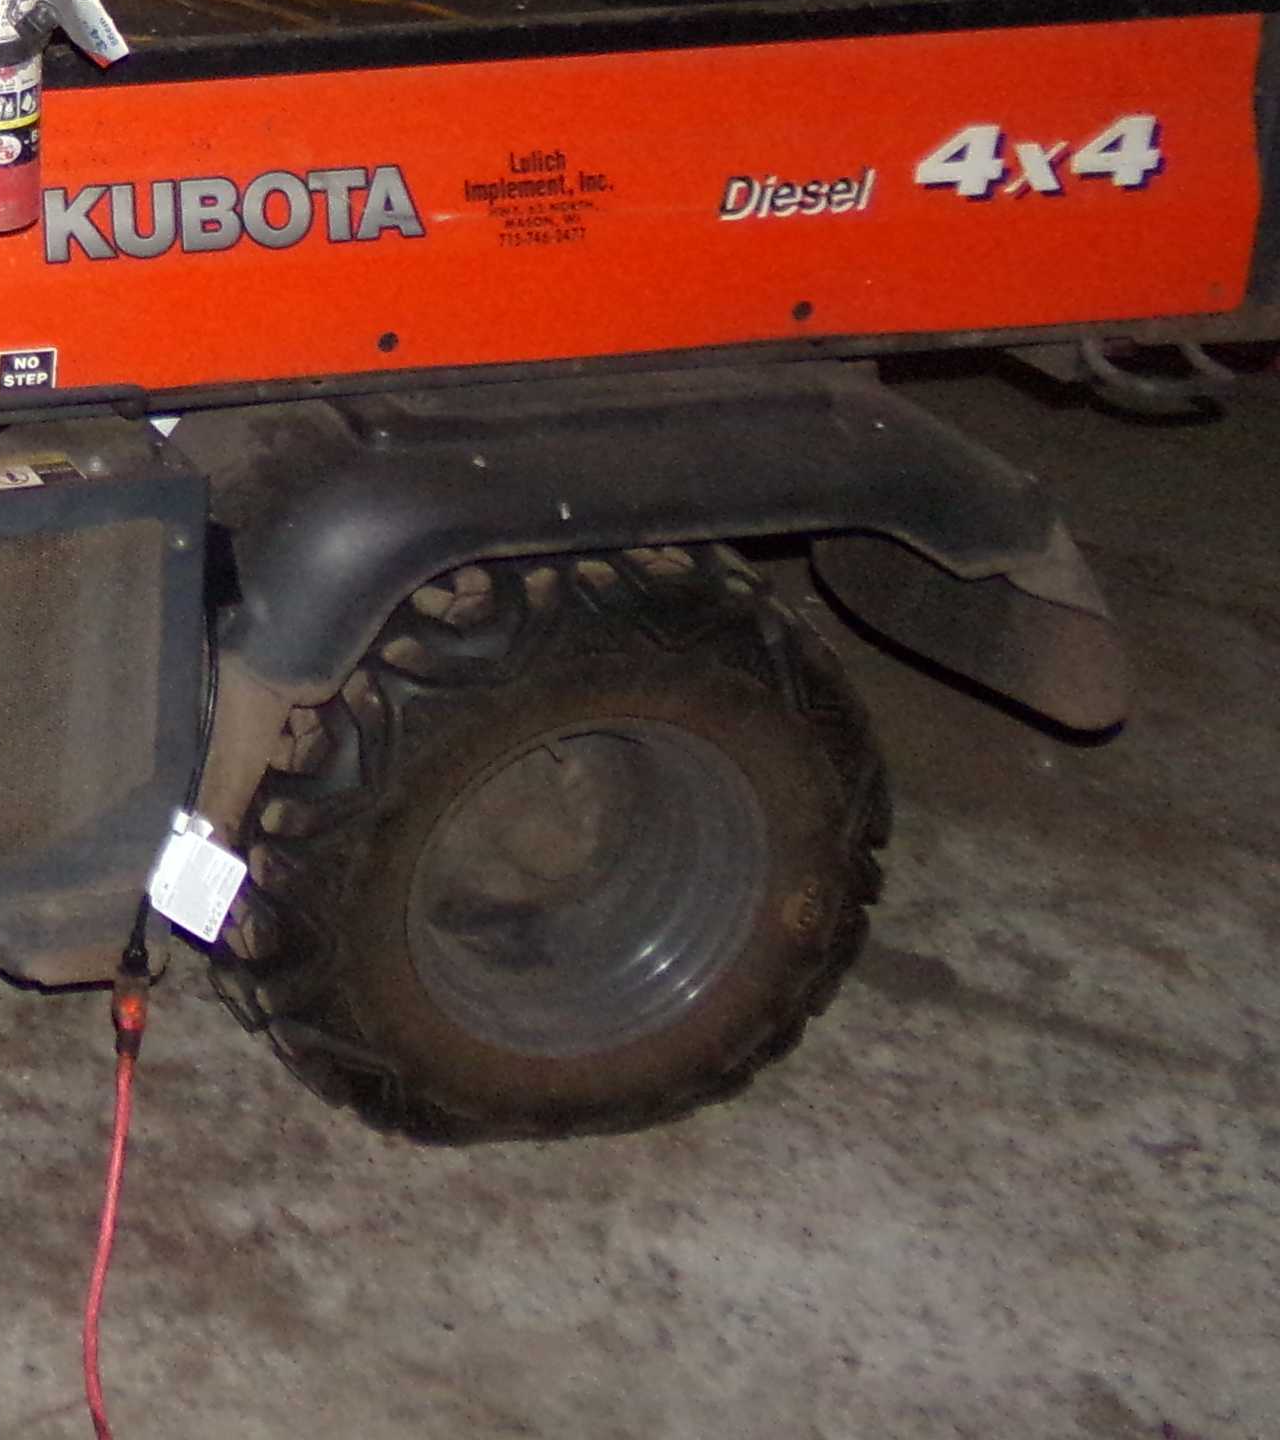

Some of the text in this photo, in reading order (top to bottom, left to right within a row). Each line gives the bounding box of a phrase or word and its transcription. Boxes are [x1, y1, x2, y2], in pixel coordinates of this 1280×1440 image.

[912, 111, 1164, 202] 4x4
[578, 170, 615, 192] Inc.
[718, 166, 875, 222] Diesel
[42, 164, 426, 264] KUBOTA
[3, 372, 49, 387] STEP
[14, 356, 40, 370] NO
